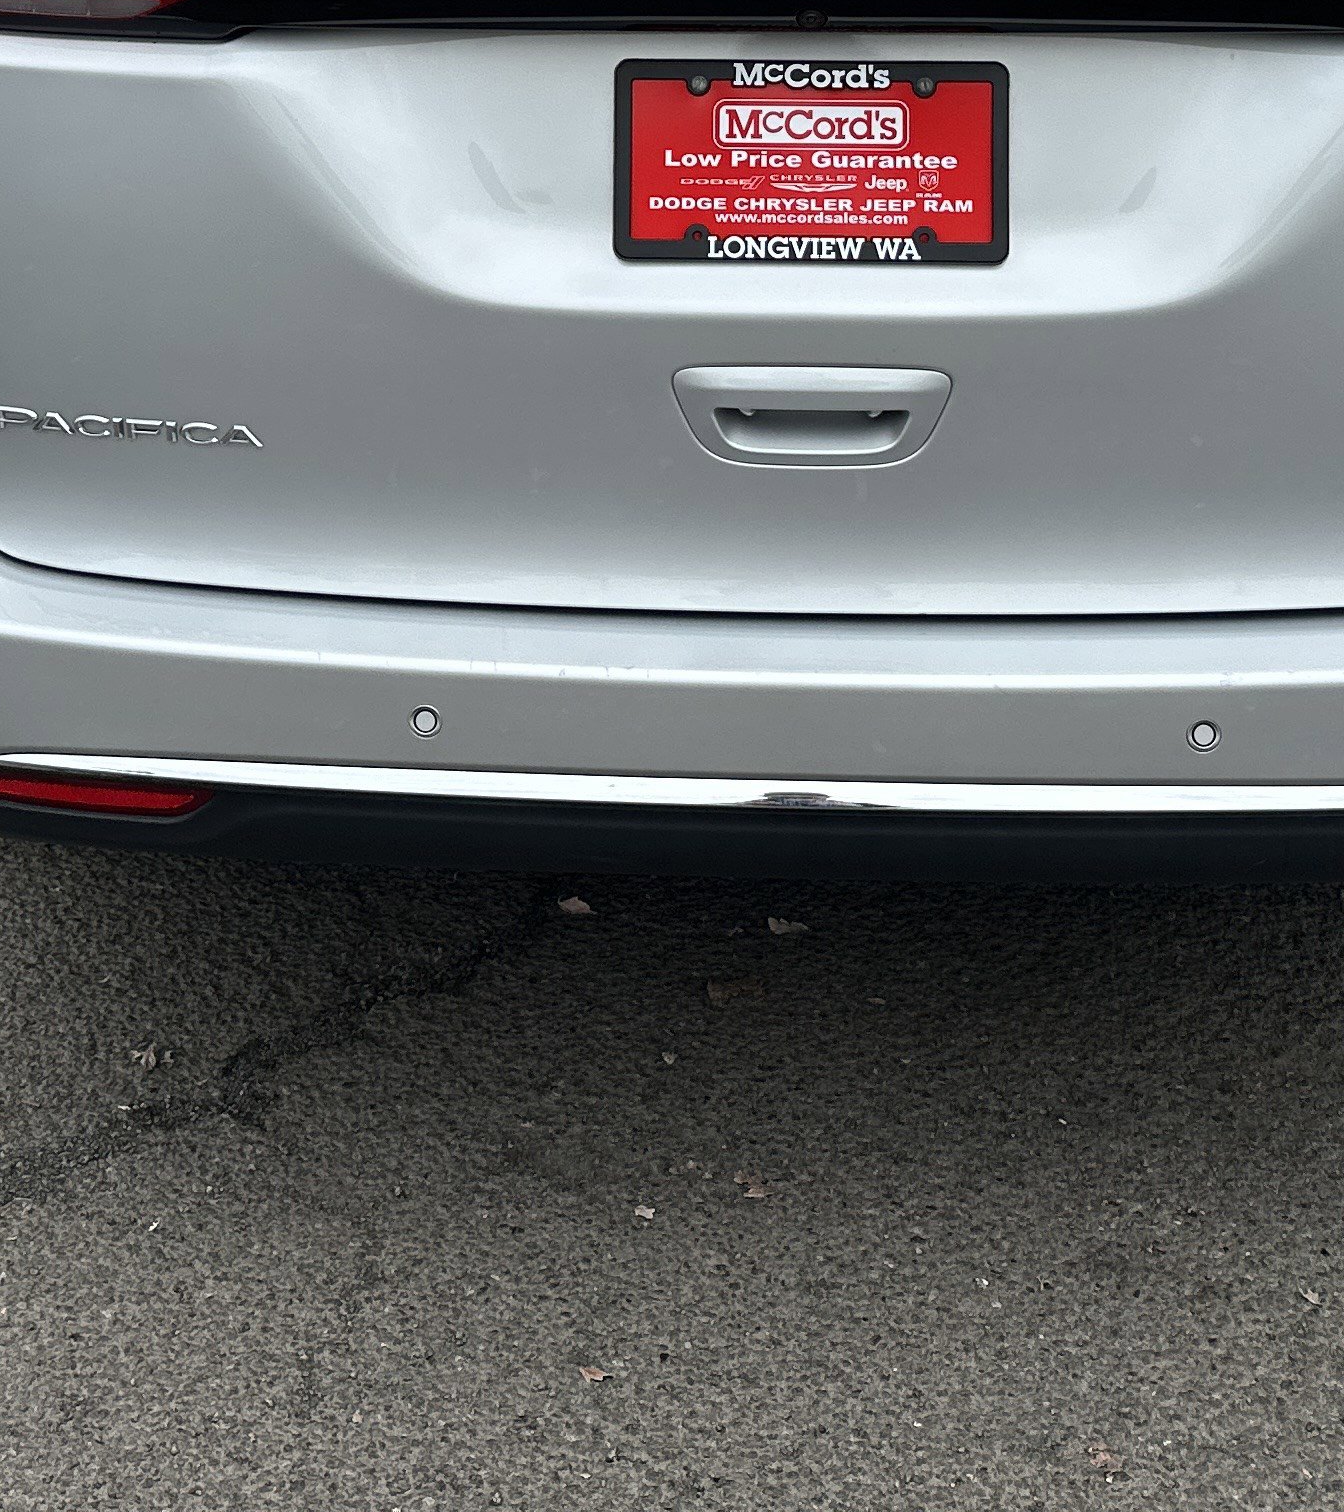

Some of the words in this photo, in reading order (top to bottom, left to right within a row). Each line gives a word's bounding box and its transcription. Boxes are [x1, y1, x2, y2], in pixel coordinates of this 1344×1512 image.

[733, 63, 891, 89] McCord's
[725, 108, 898, 141] McCord's
[664, 150, 721, 168] Low
[731, 151, 803, 169] Price
[811, 151, 958, 170] Guarantee
[769, 174, 857, 182] CHRYSLER
[864, 174, 908, 192] Jeep
[649, 197, 727, 210] DODGE
[734, 197, 853, 211] CHRYSLER
[859, 199, 916, 212] JEEP
[923, 200, 973, 213] RAM
[715, 212, 909, 225] www.mccordsales.com
[707, 235, 866, 260] LONGVIEW
[876, 237, 922, 260] WA
